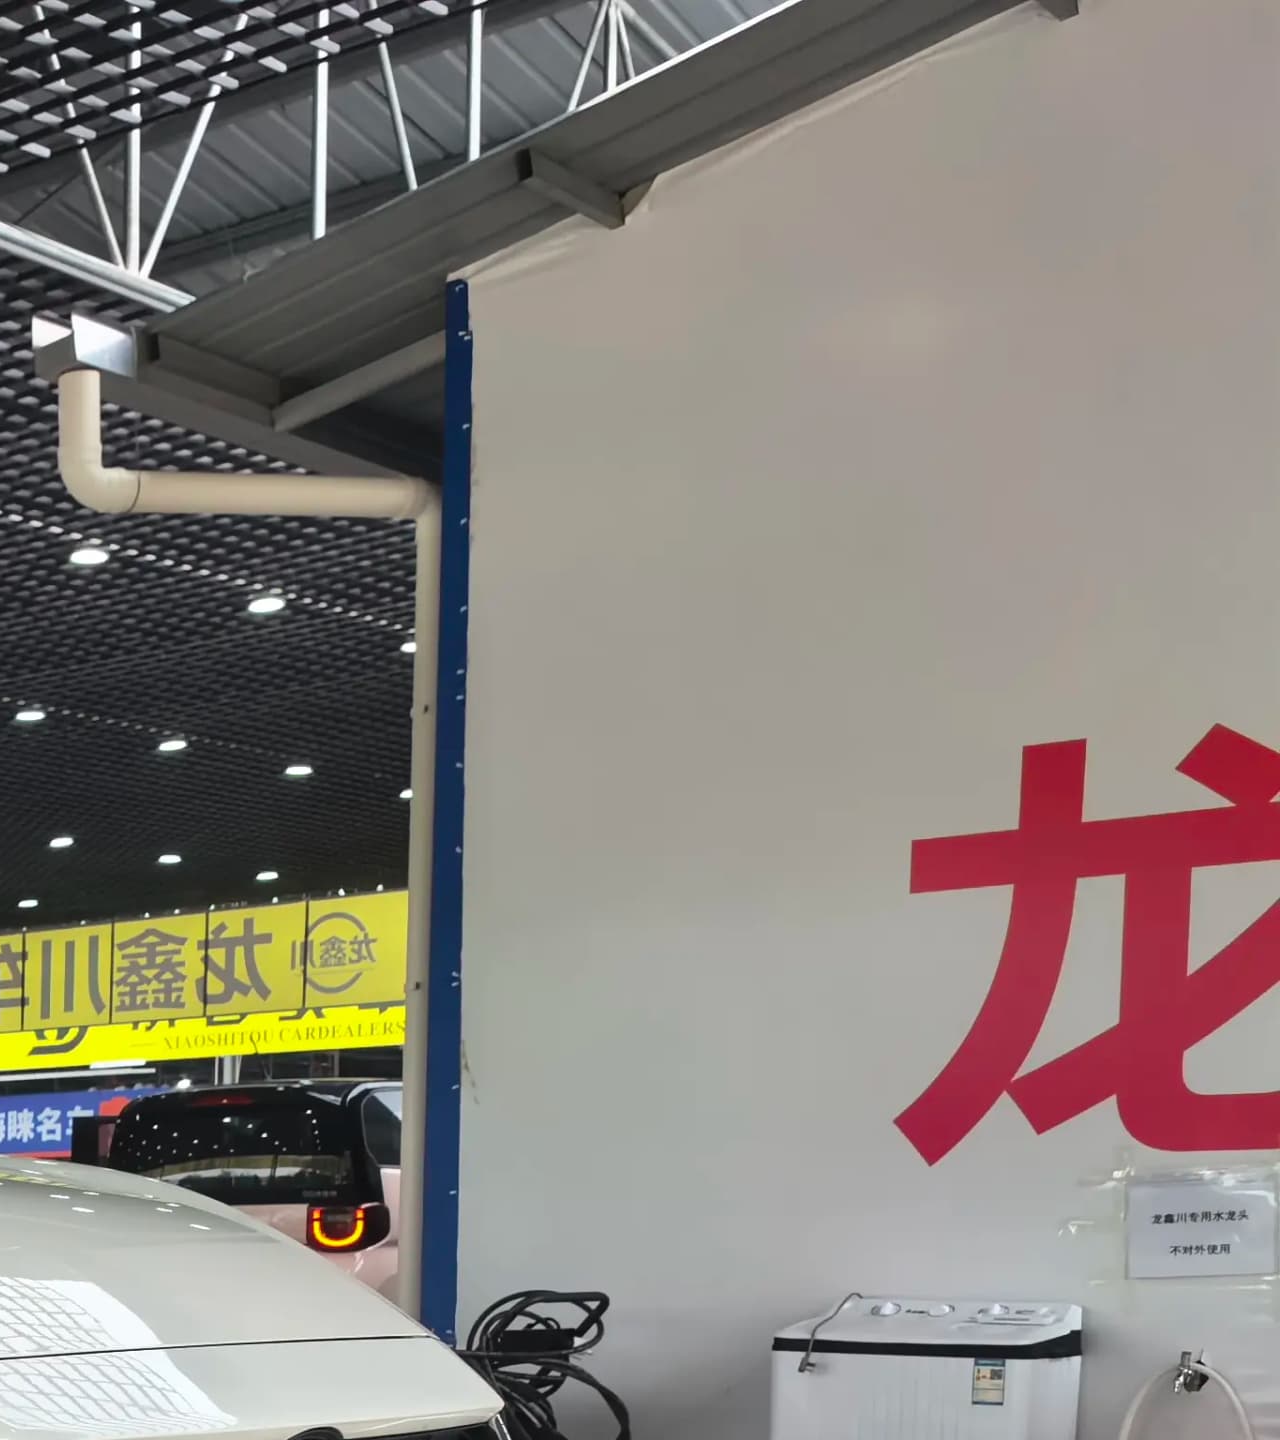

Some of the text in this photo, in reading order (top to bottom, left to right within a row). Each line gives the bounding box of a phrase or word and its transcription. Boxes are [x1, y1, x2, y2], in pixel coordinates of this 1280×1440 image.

[893, 723, 1280, 1167] 龙
[1151, 1209, 1250, 1225] 龙鑫川专用水龙头
[1169, 1243, 1232, 1257] 不对外使用
